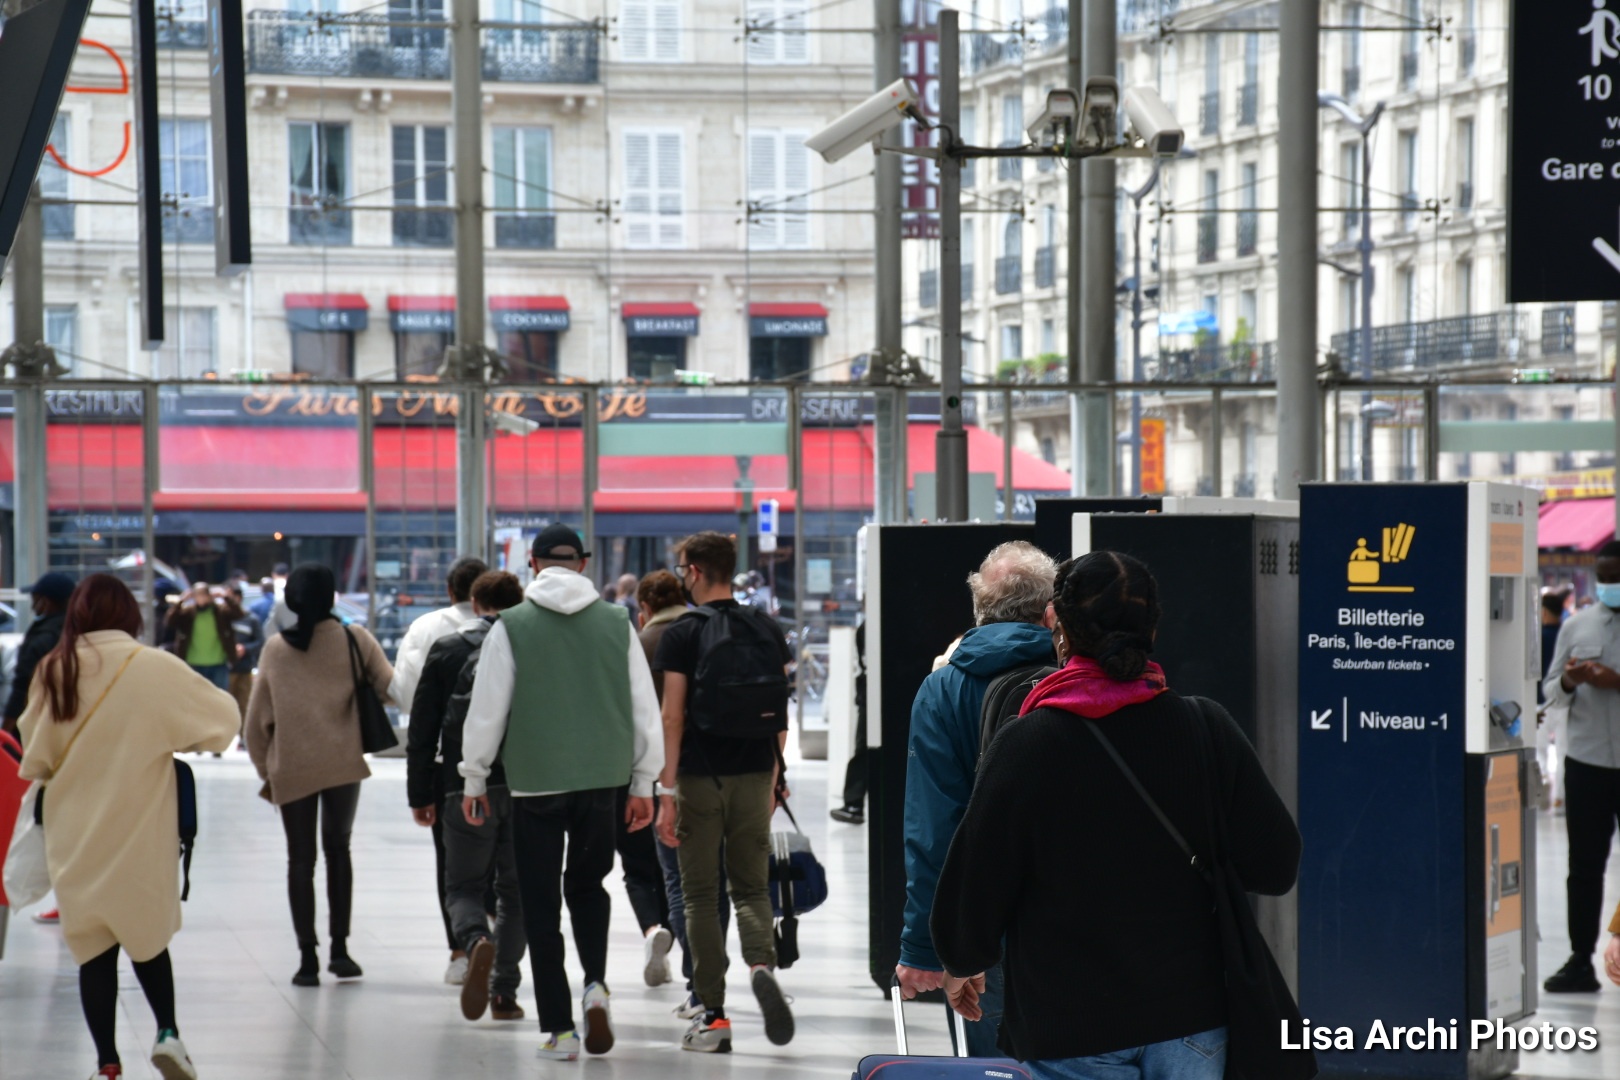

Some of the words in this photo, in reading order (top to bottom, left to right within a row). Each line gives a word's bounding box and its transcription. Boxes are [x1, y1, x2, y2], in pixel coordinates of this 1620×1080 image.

[1578, 74, 1612, 101] 10
[1601, 138, 1615, 149] to
[1542, 157, 1604, 181] Gare
[634, 319, 695, 332] BREAKFAST
[764, 321, 824, 334] LIMONADE
[751, 398, 859, 419] BRSERIE
[1338, 608, 1425, 627] Billetterie
[1308, 634, 1350, 650] Paris,
[1354, 632, 1455, 650] Île-de-France
[1333, 658, 1385, 670] Suburban
[1387, 659, 1423, 671] tickets
[1360, 711, 1425, 730] Niveau
[1431, 713, 1448, 731] -1
